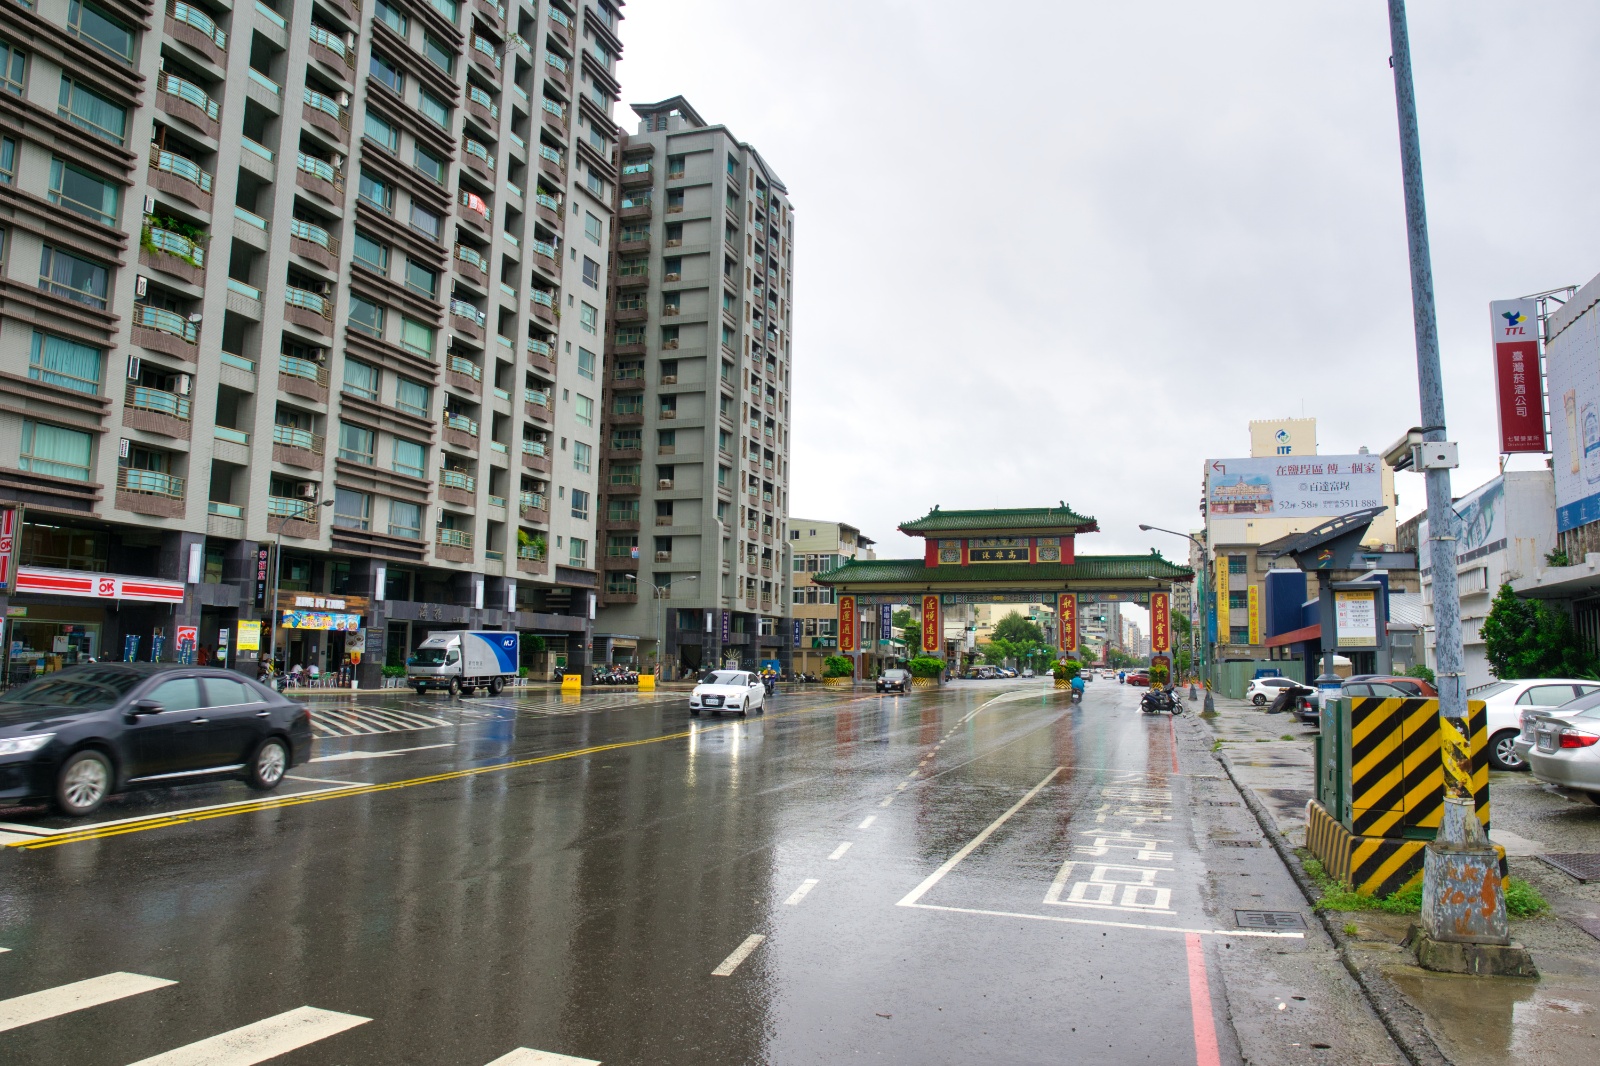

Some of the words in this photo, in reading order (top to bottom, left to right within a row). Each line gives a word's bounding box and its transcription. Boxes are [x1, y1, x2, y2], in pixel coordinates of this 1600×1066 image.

[1504, 326, 1526, 336] TTL
[1512, 350, 1528, 417] 臺灣菸酒公司
[1276, 446, 1292, 455] ITF
[1276, 464, 1324, 476] 在鹽埕區
[1327, 462, 1376, 475] 傳一個家
[1310, 481, 1350, 492] 百達富埕
[982, 550, 1017, 560] 高雄港
[99, 582, 114, 593] OK
[841, 599, 852, 648] 五運通達
[1155, 596, 1166, 649] 萬商雲集
[1043, 771, 1178, 915] 公車停靠區
